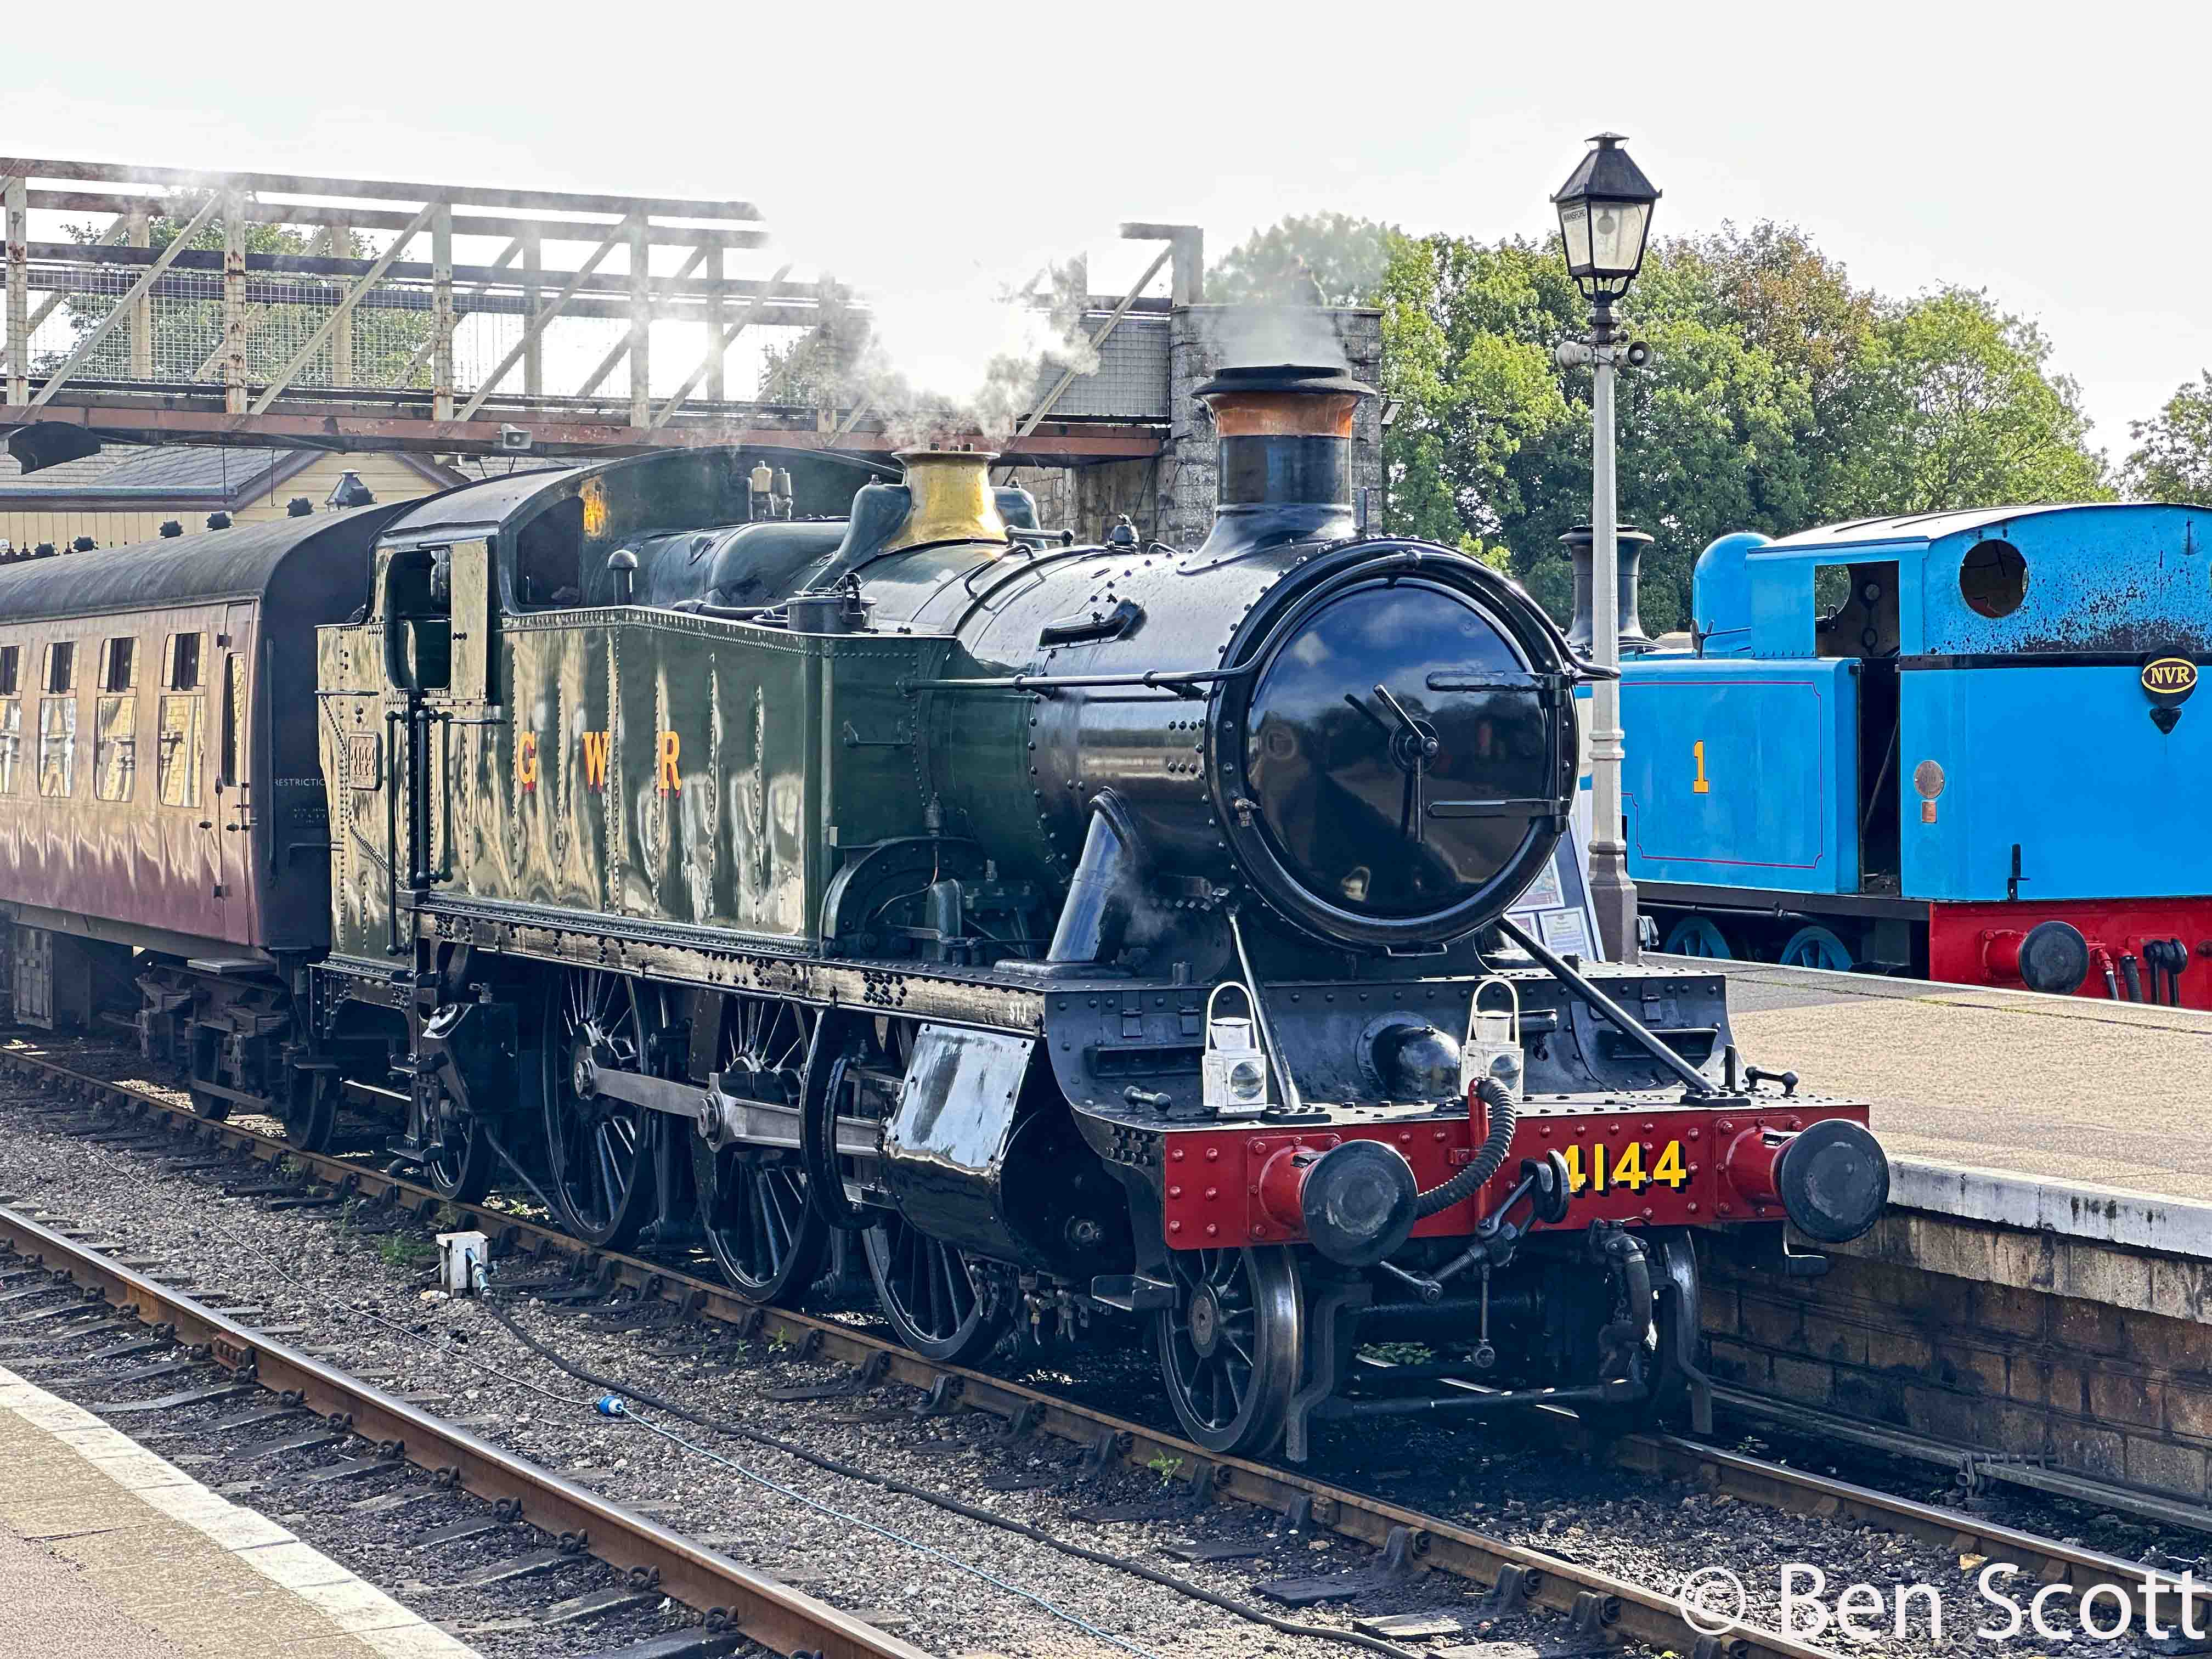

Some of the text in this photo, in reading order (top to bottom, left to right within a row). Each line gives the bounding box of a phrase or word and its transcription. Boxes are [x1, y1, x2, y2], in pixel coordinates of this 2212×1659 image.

[1563, 210, 1585, 221] WANSFORD
[2151, 666, 2191, 685] NVR
[1693, 740, 1709, 794] 1
[1009, 1001, 1026, 1024] STJ
[1563, 1140, 1690, 1195] 4144
